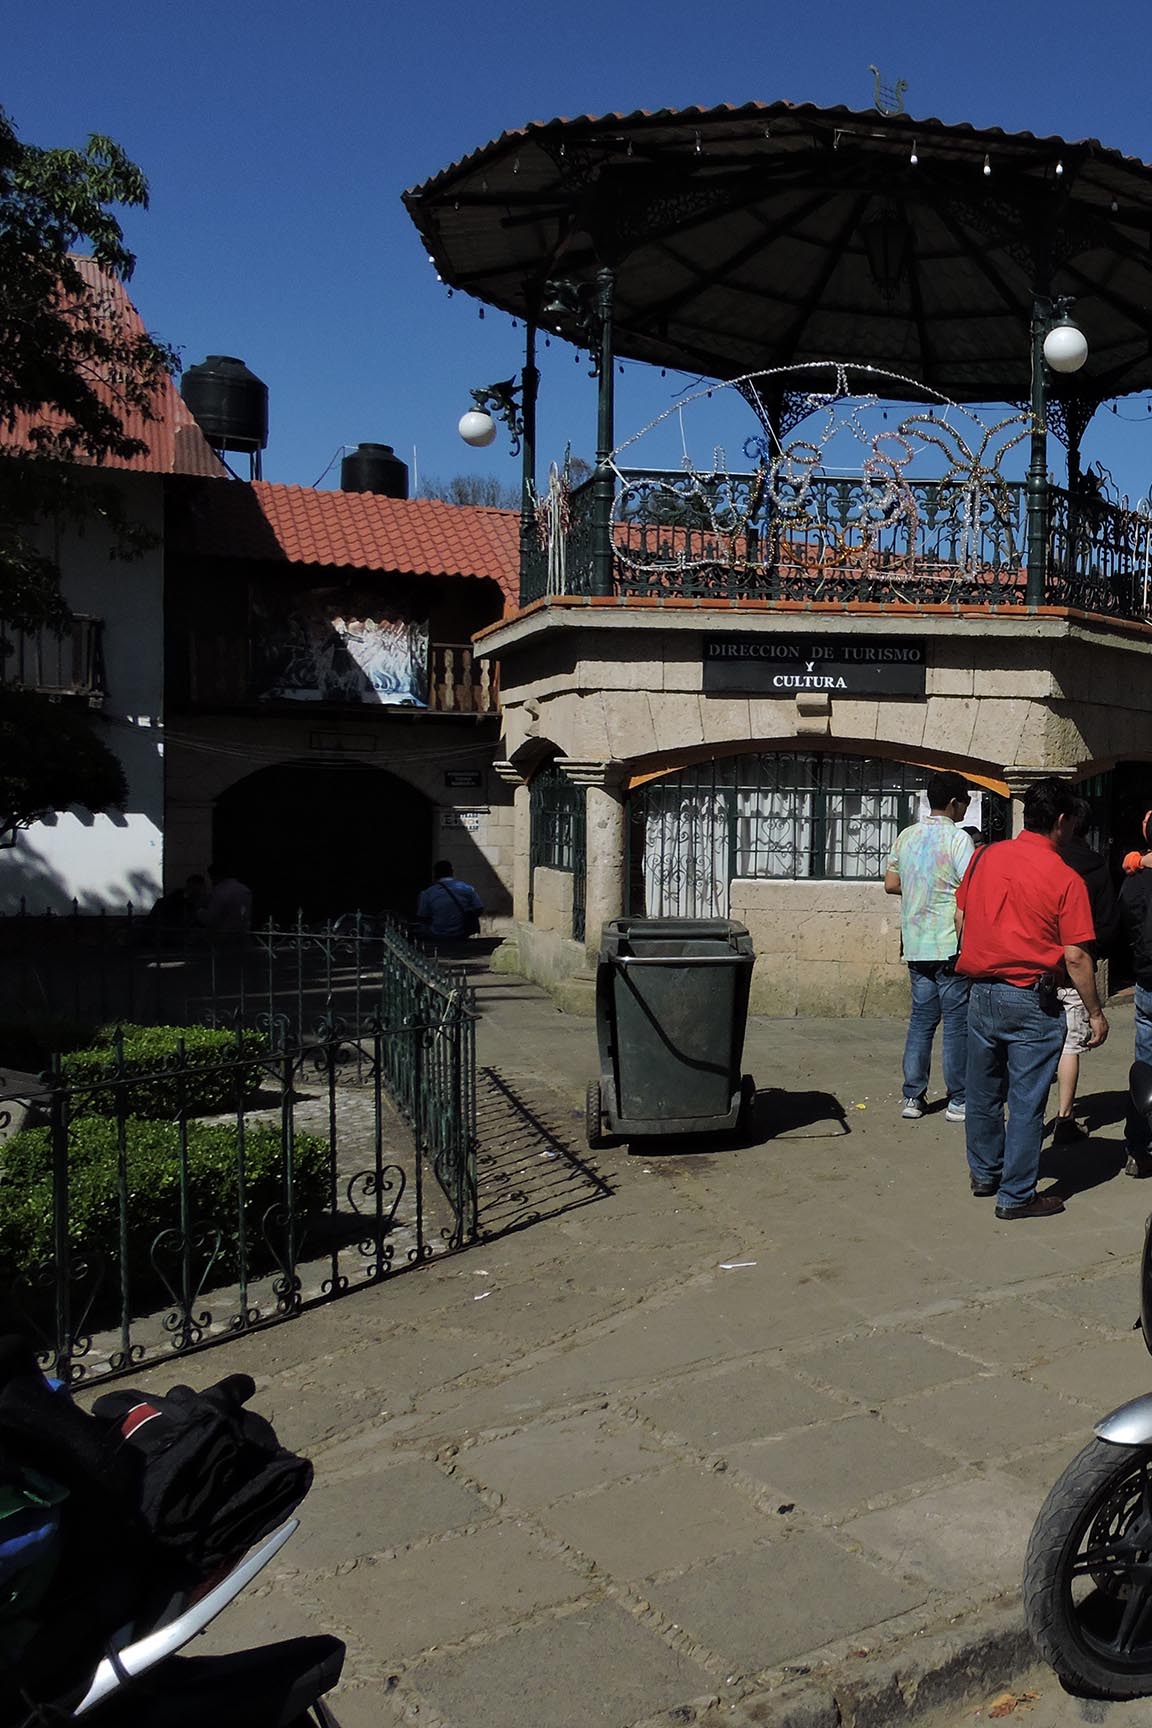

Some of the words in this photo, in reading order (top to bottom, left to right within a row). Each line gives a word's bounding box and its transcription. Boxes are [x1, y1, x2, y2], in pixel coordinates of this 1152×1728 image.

[709, 643, 800, 658] DIRECCION
[811, 646, 834, 659] DE
[844, 647, 921, 661] TURISMO
[805, 662, 815, 672] Y
[773, 676, 848, 689] CULTURA
